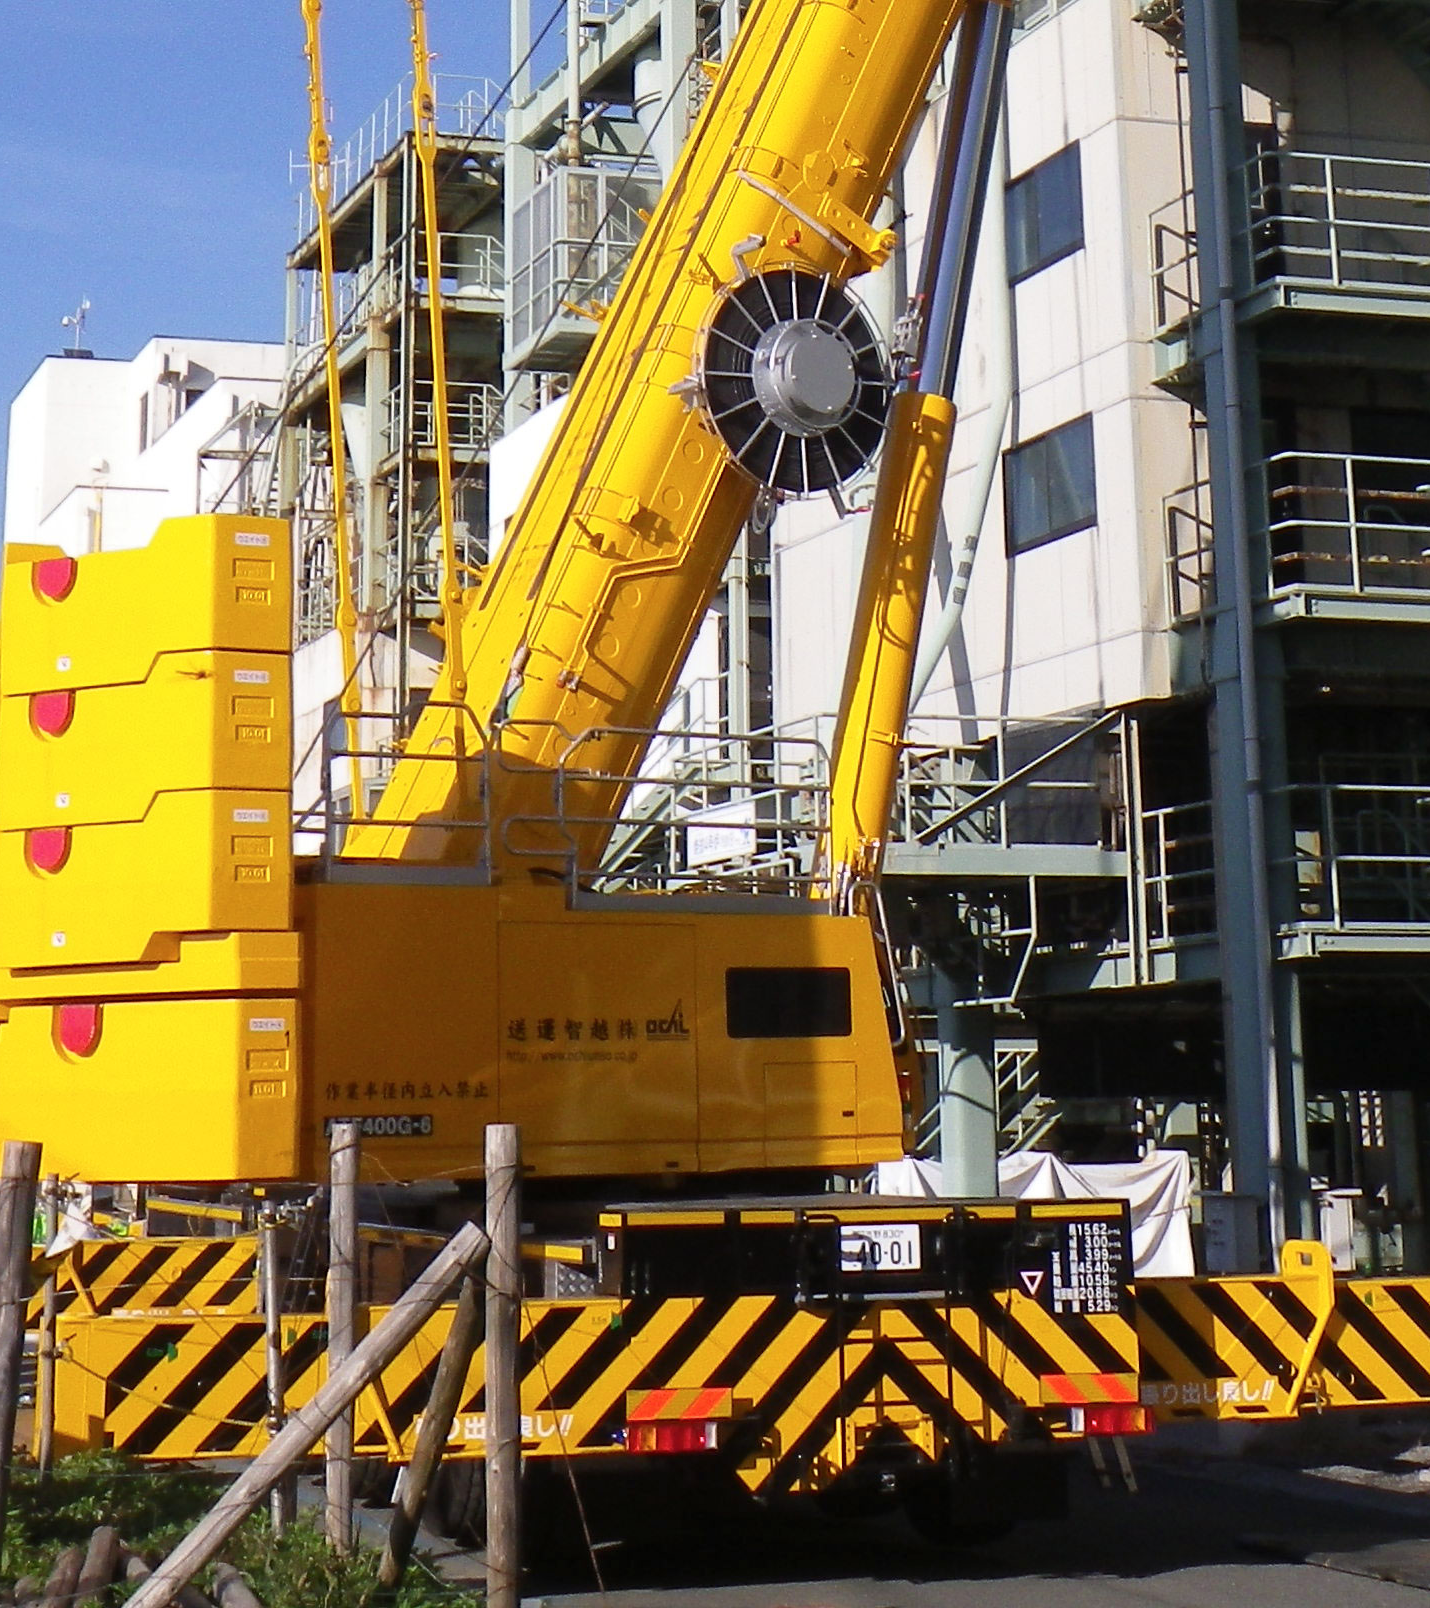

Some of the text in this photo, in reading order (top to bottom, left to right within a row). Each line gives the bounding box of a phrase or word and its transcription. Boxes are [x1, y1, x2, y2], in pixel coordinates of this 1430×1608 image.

[326, 1080, 489, 1100] 作業半径内立入禁止
[325, 1116, 432, 1136] AF400G-6
